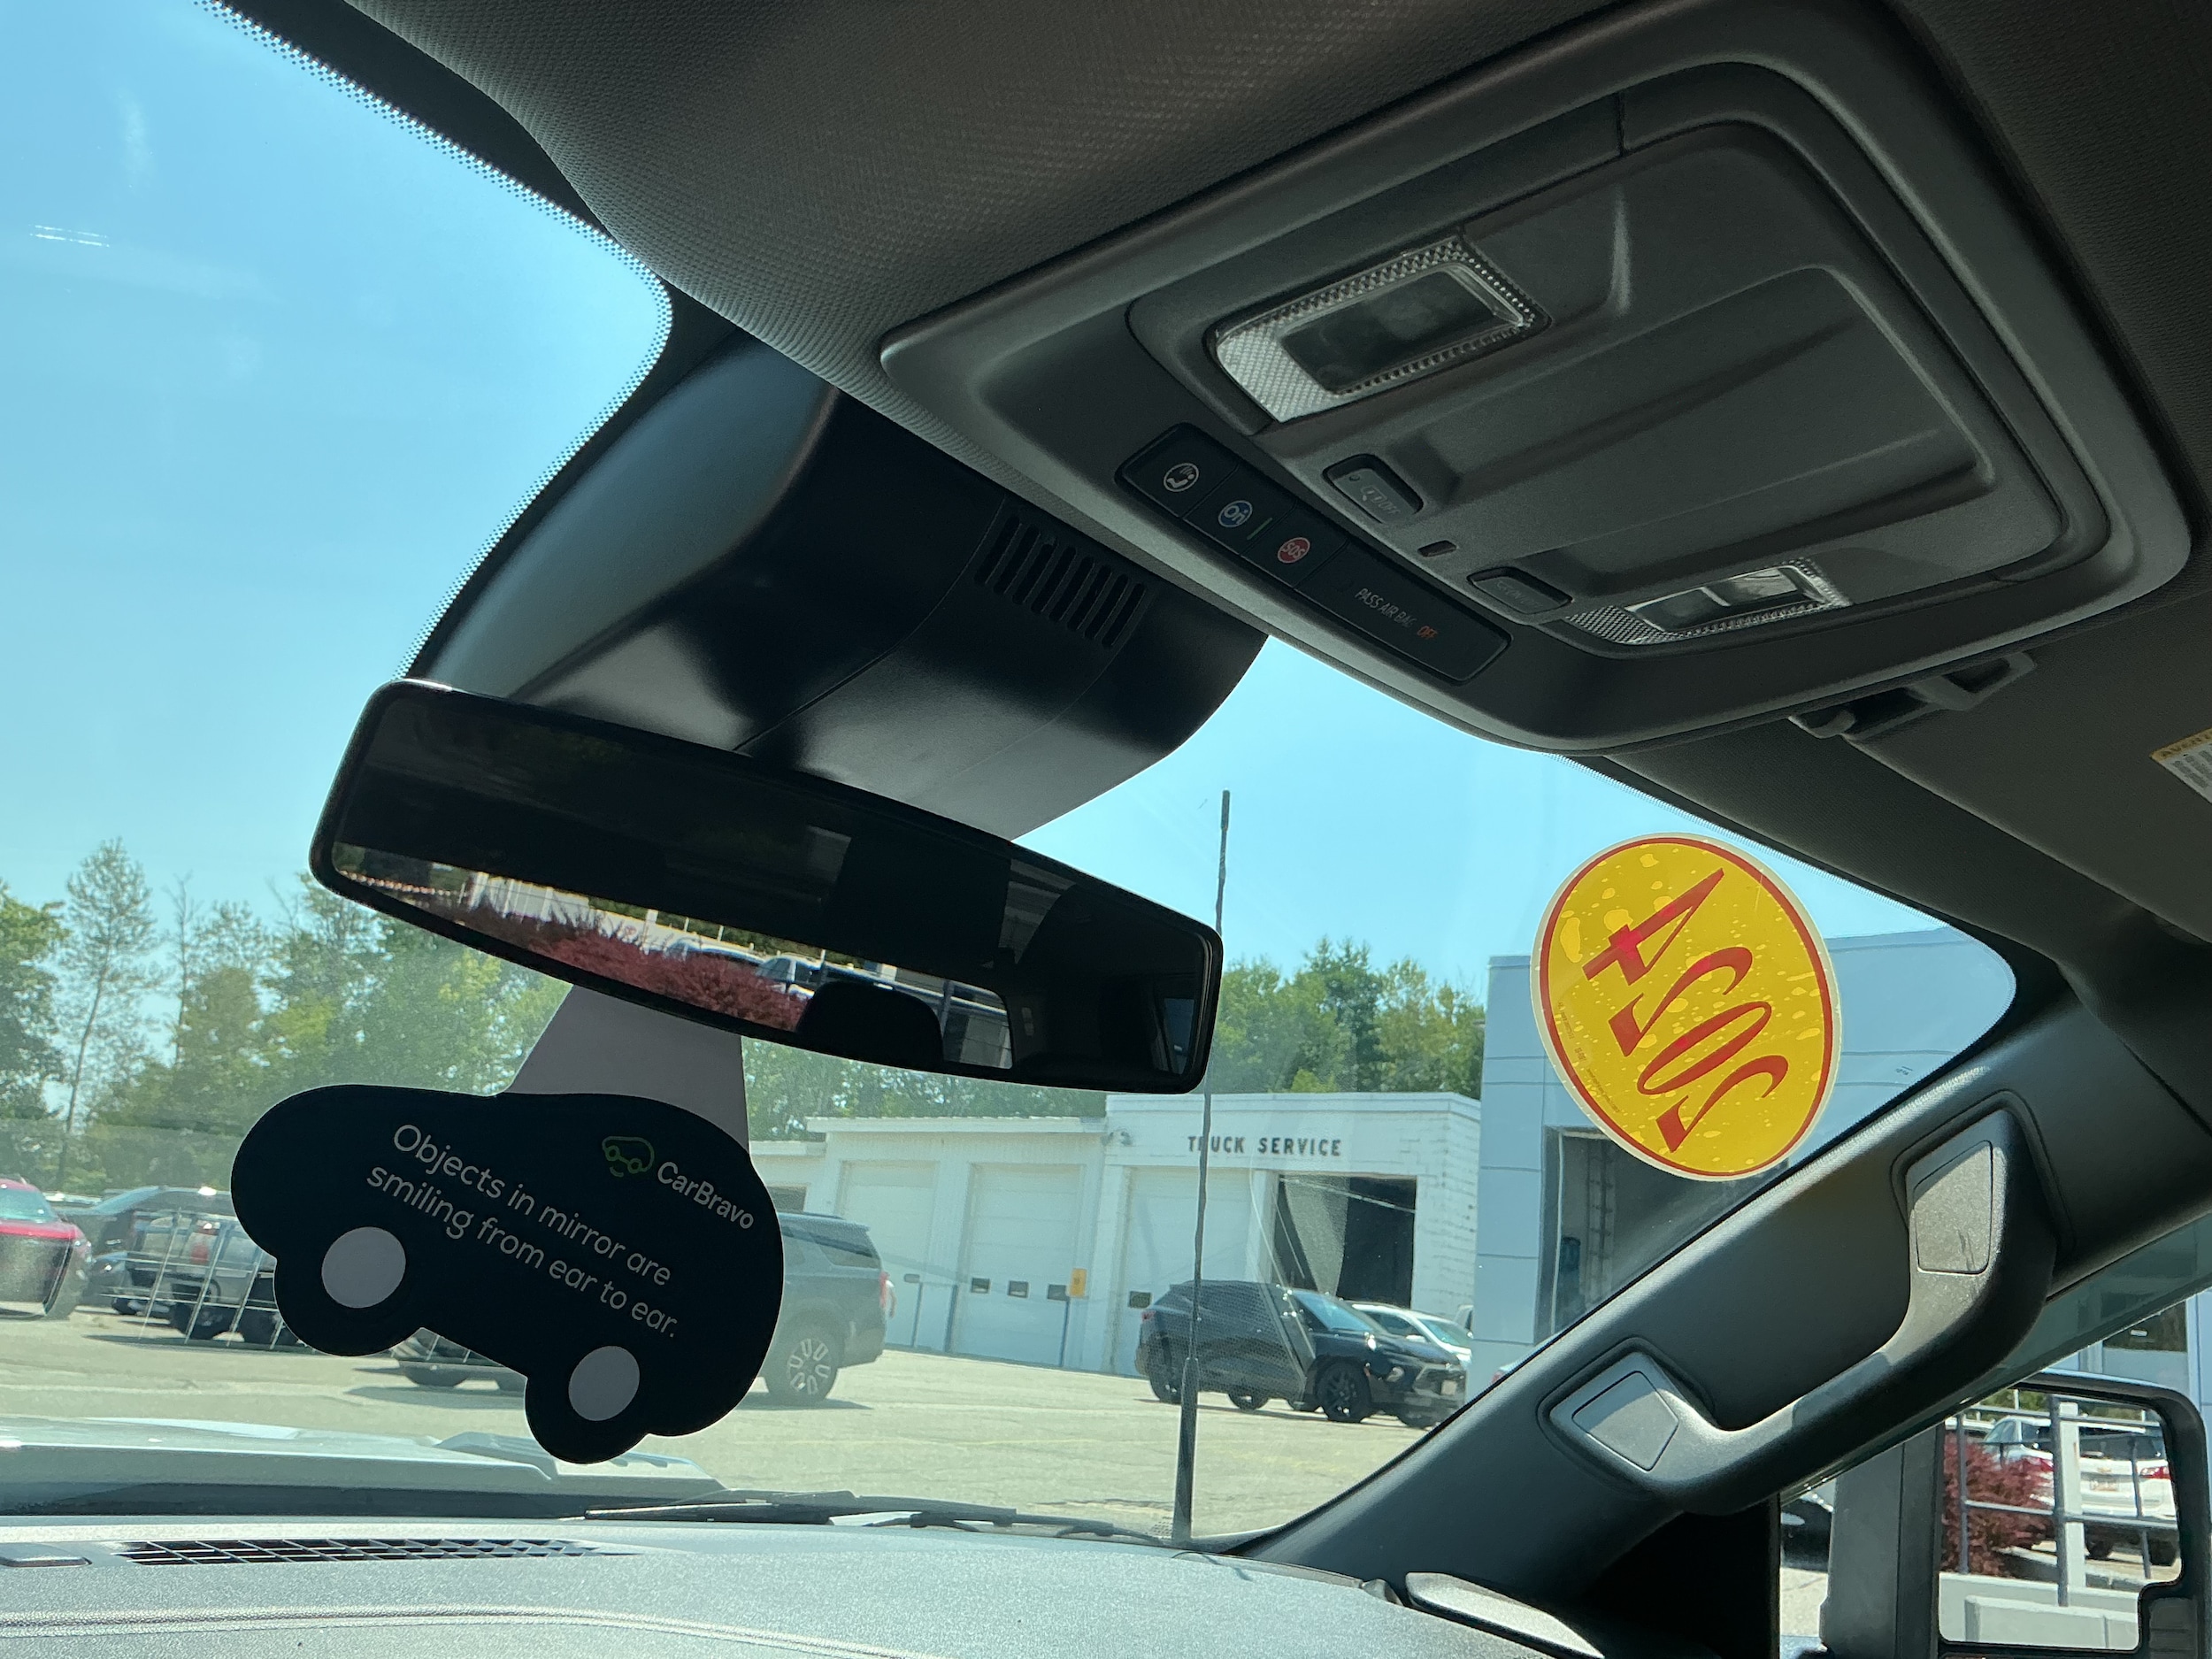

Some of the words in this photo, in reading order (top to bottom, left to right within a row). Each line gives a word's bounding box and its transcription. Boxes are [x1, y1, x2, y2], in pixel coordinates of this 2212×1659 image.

[1281, 541, 1306, 559] SOS
[1354, 588, 1384, 609] PASS
[1378, 603, 1399, 618] AIR
[1256, 1136, 1342, 1157] SERVICE
[393, 1124, 505, 1199] Objects
[507, 1183, 535, 1216] in
[538, 1206, 626, 1259] mirror
[626, 1253, 671, 1286] are
[657, 1161, 754, 1229] CarBravo
[366, 1166, 474, 1240] smiling
[477, 1217, 545, 1269] from
[549, 1260, 598, 1292] ear
[600, 1280, 627, 1310] to
[631, 1302, 678, 1338] ear.
